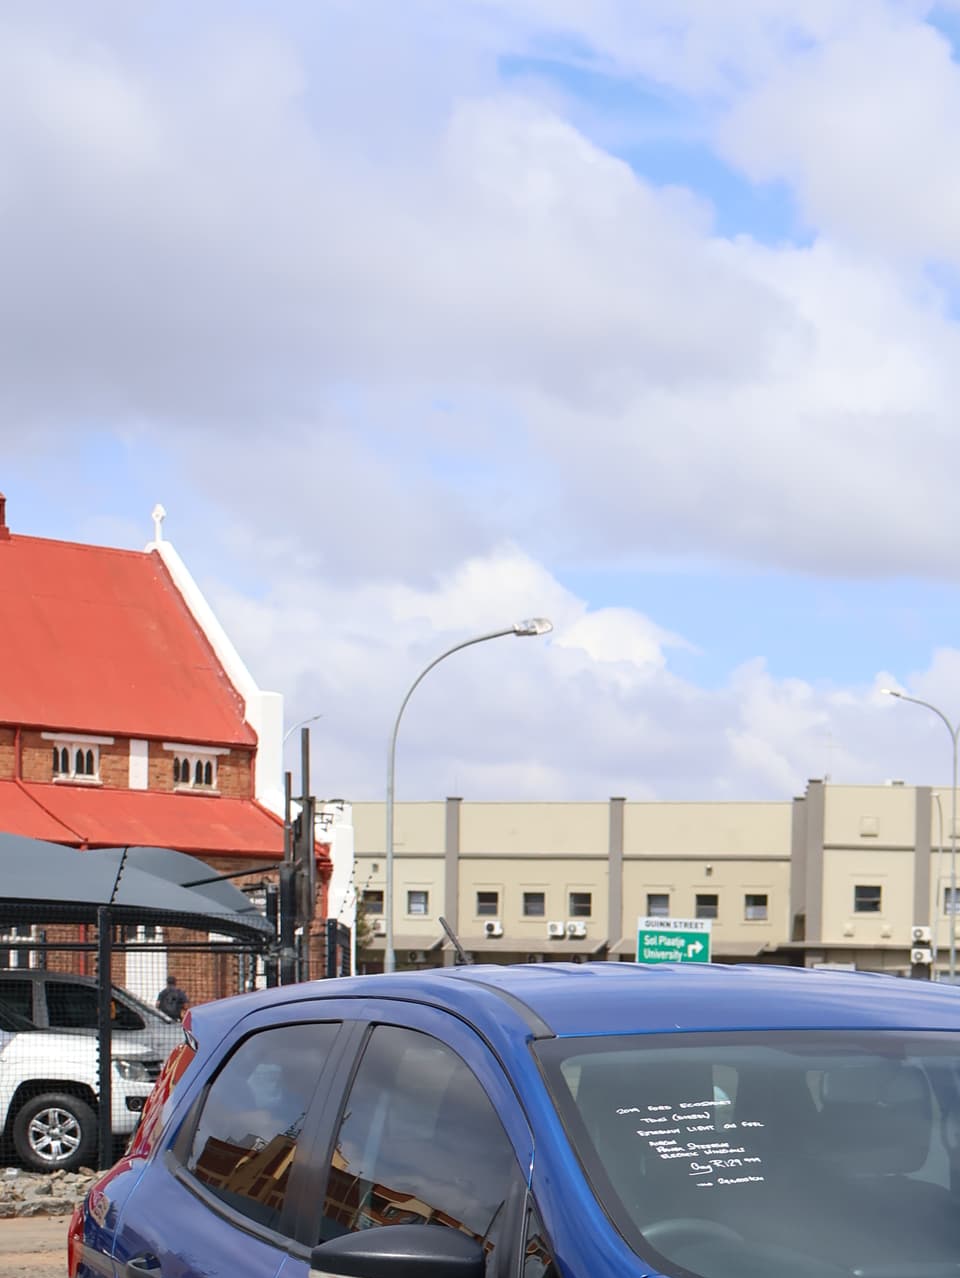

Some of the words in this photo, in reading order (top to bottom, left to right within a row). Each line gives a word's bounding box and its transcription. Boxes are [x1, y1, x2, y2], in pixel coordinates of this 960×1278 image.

[644, 920, 671, 928] QUINN
[673, 921, 704, 929] STREET
[644, 935, 657, 946] Sol
[658, 935, 686, 949] Plaatje
[643, 948, 682, 962] University
